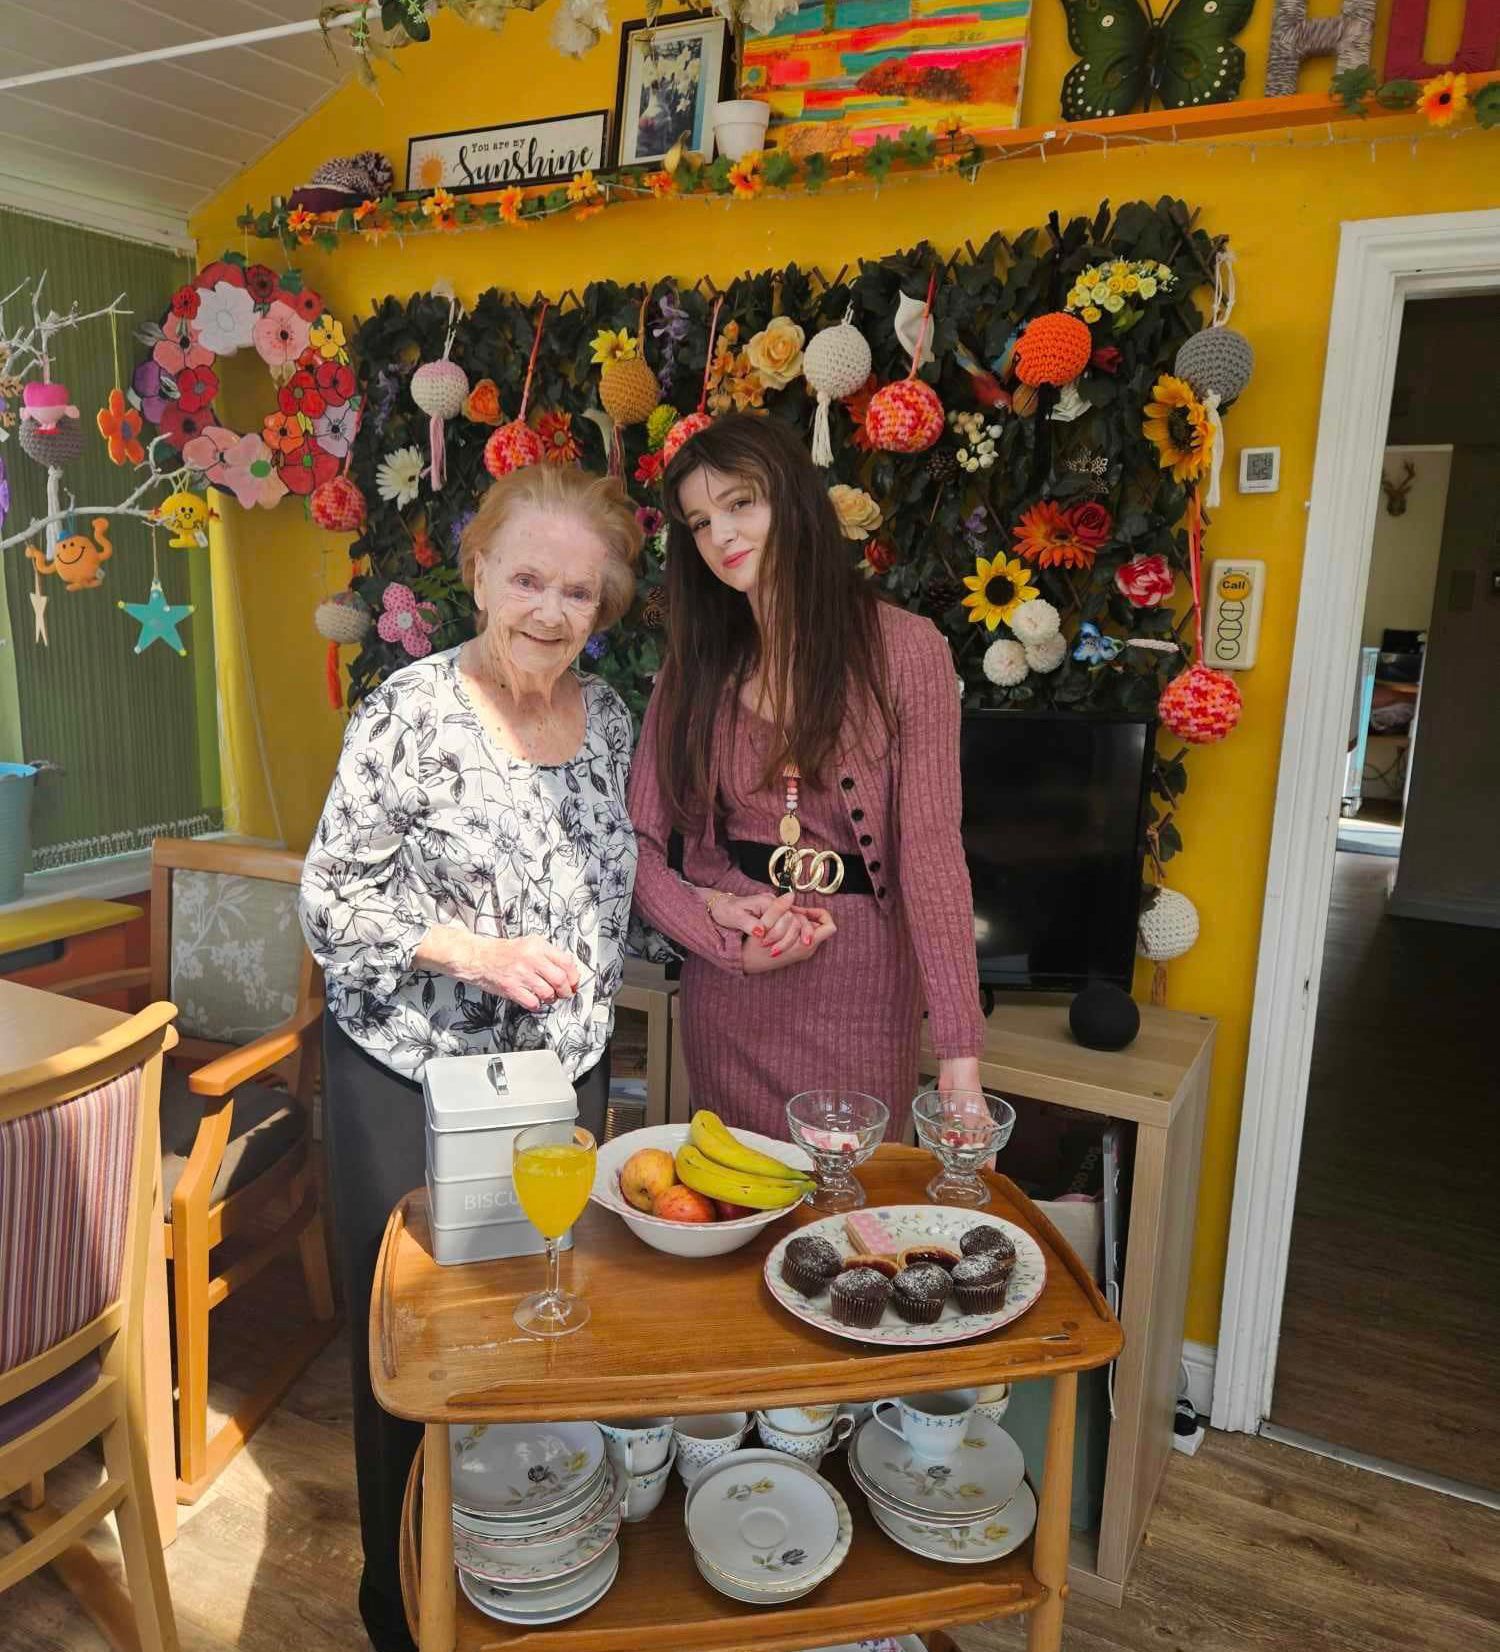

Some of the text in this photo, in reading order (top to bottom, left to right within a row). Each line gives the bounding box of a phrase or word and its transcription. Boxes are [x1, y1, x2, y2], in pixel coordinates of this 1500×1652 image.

[471, 138, 526, 153] You are my
[452, 136, 594, 186] Sunshine
[1222, 580, 1246, 590] Call
